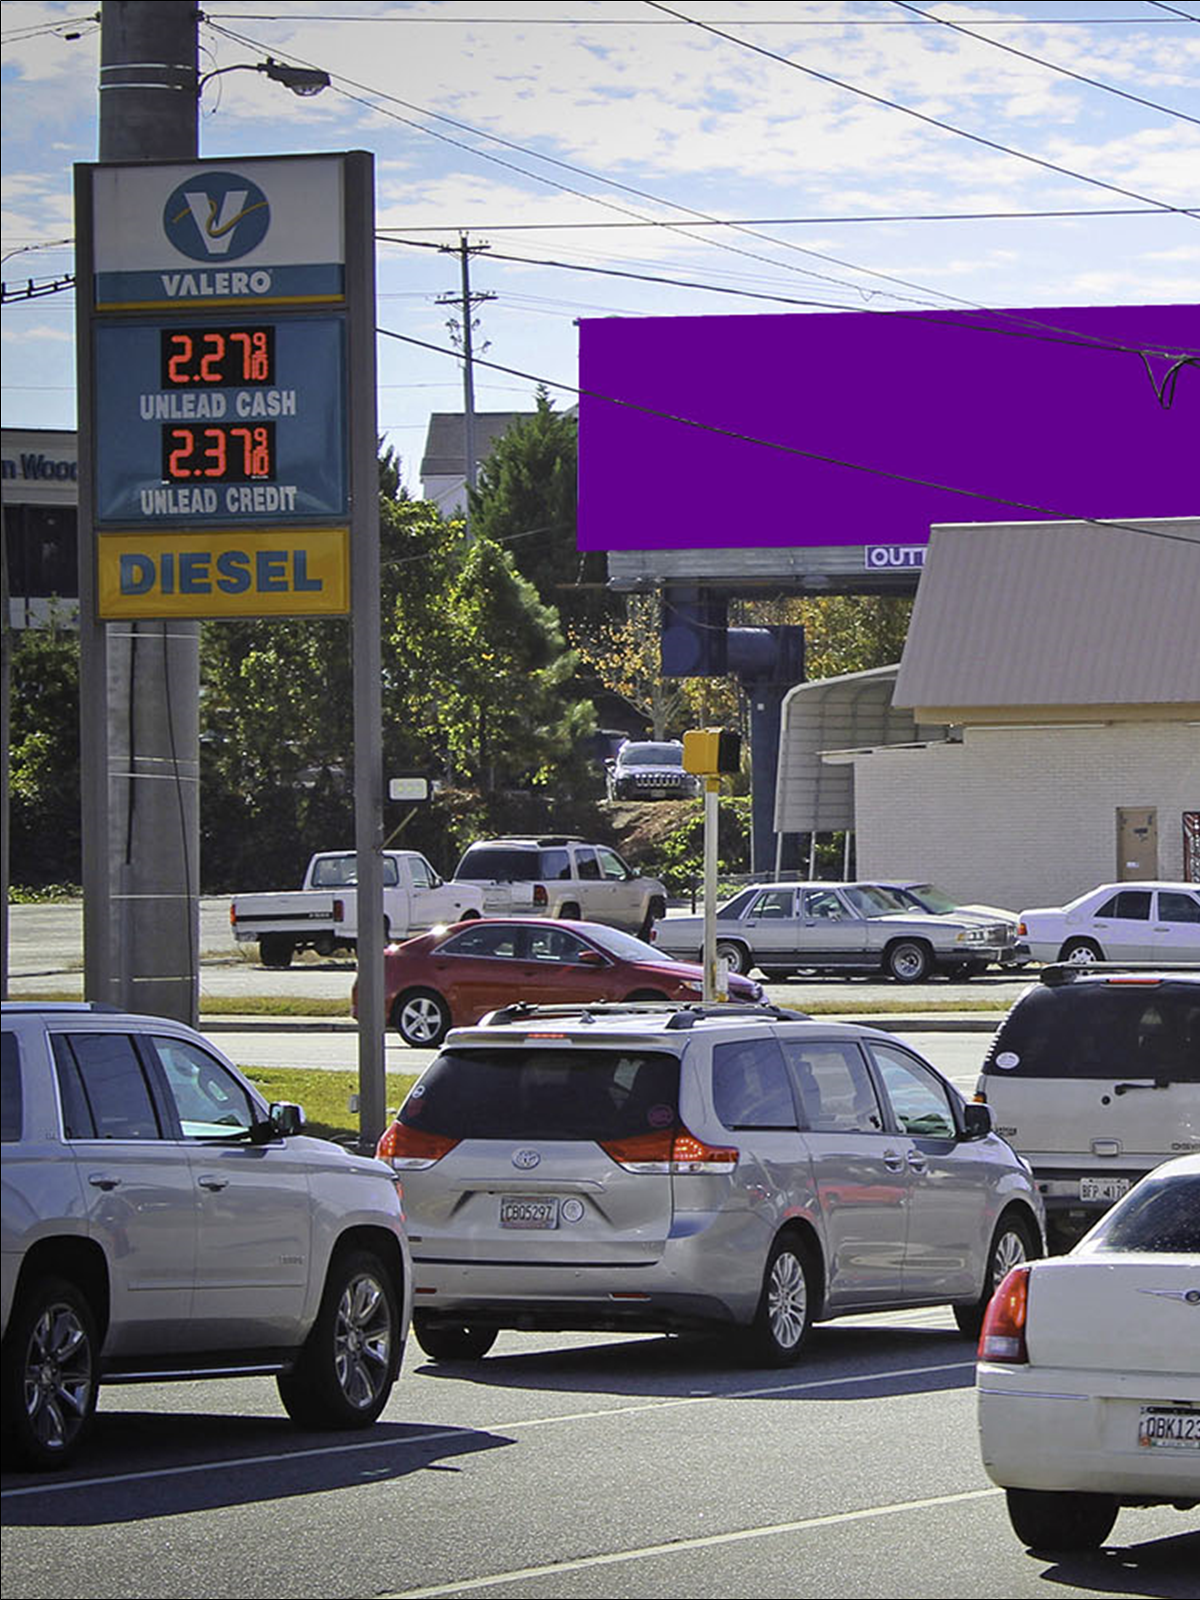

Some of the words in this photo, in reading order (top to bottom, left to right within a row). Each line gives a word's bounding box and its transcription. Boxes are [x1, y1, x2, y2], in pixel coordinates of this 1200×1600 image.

[161, 270, 272, 297] VALERO
[140, 393, 227, 420] UNLEAD
[236, 391, 297, 417] CASH
[140, 488, 218, 516] UNLEAD
[226, 485, 298, 513] CREDIT
[119, 549, 324, 596] DIESEL
